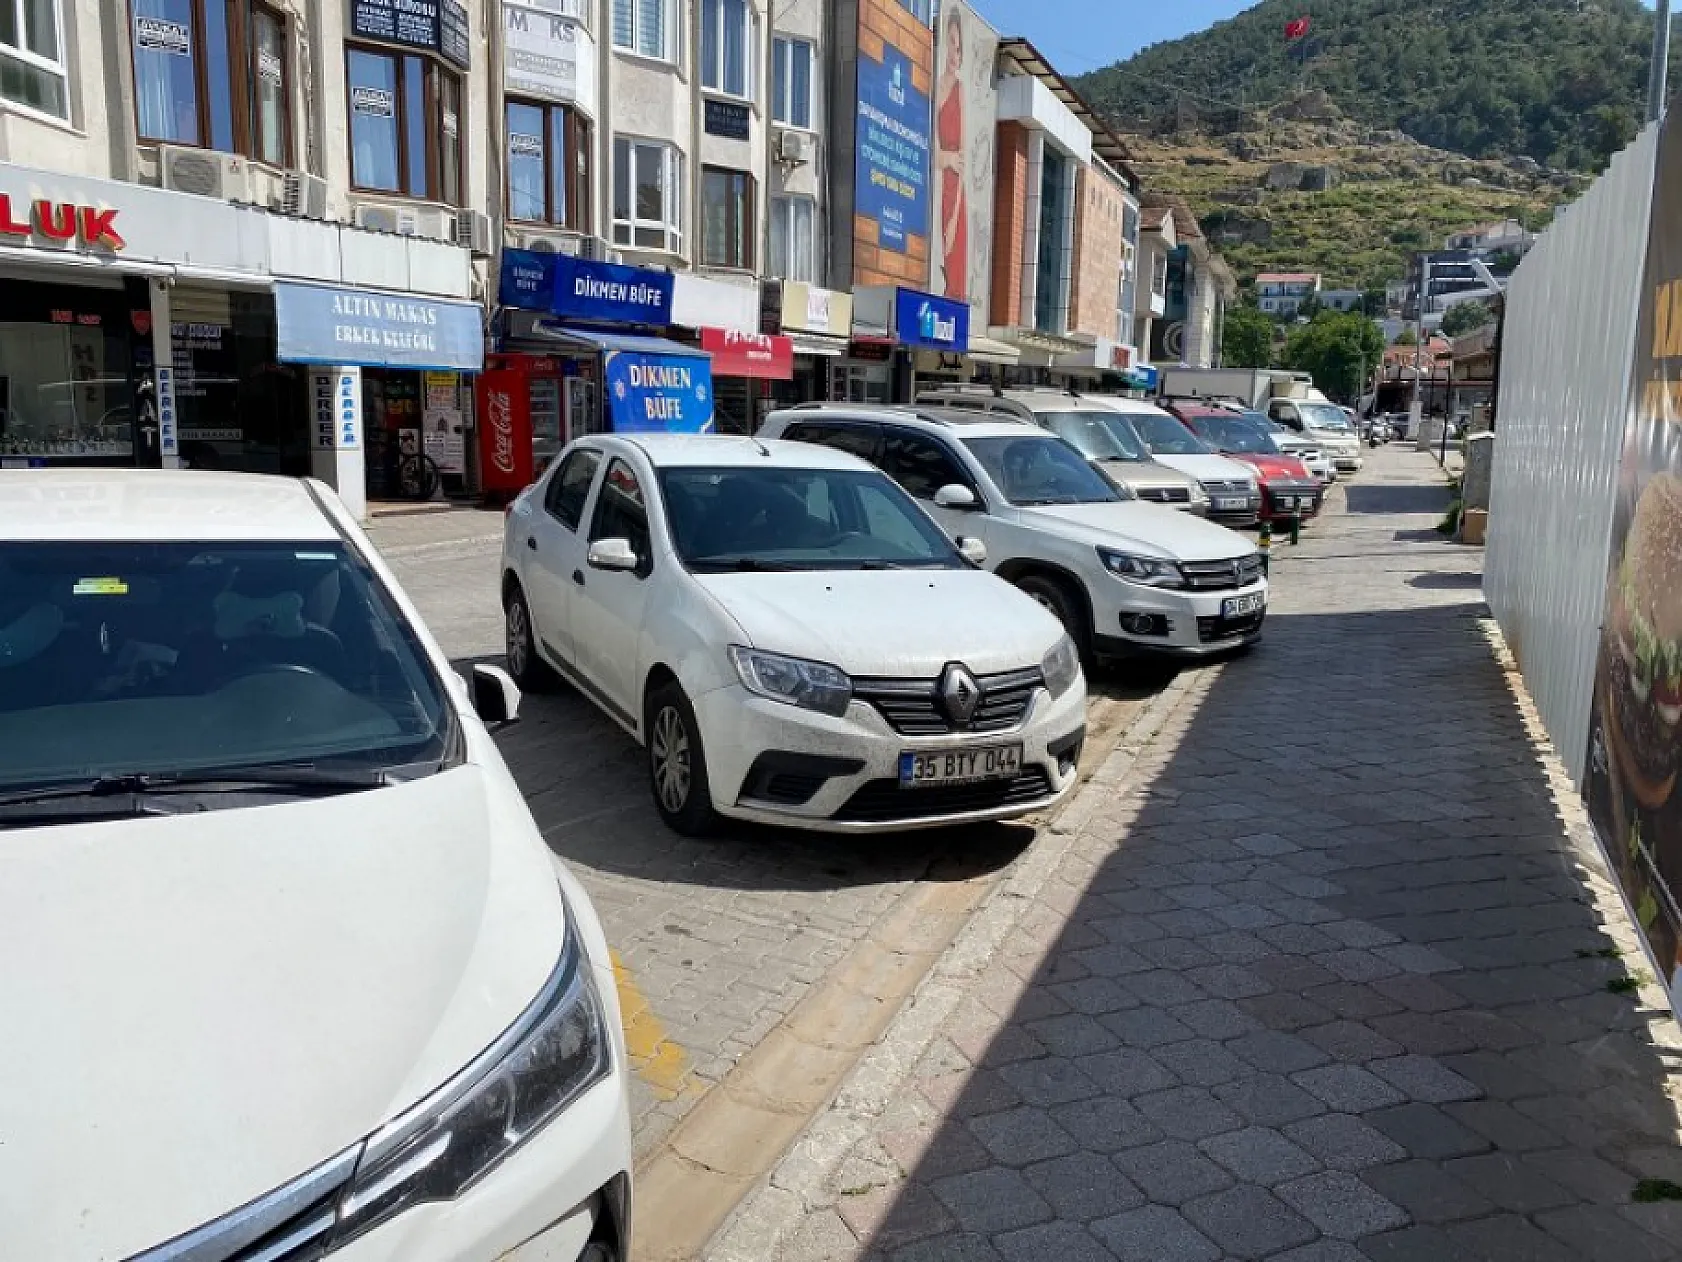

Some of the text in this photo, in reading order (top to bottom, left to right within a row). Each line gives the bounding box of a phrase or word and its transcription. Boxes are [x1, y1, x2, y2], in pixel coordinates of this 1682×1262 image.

[574, 275, 662, 306] DİKMEN BÜFE
[629, 358, 691, 389] DİKMEN
[644, 391, 684, 421] BÜFE
[915, 747, 1018, 778] 35 BTY 044
